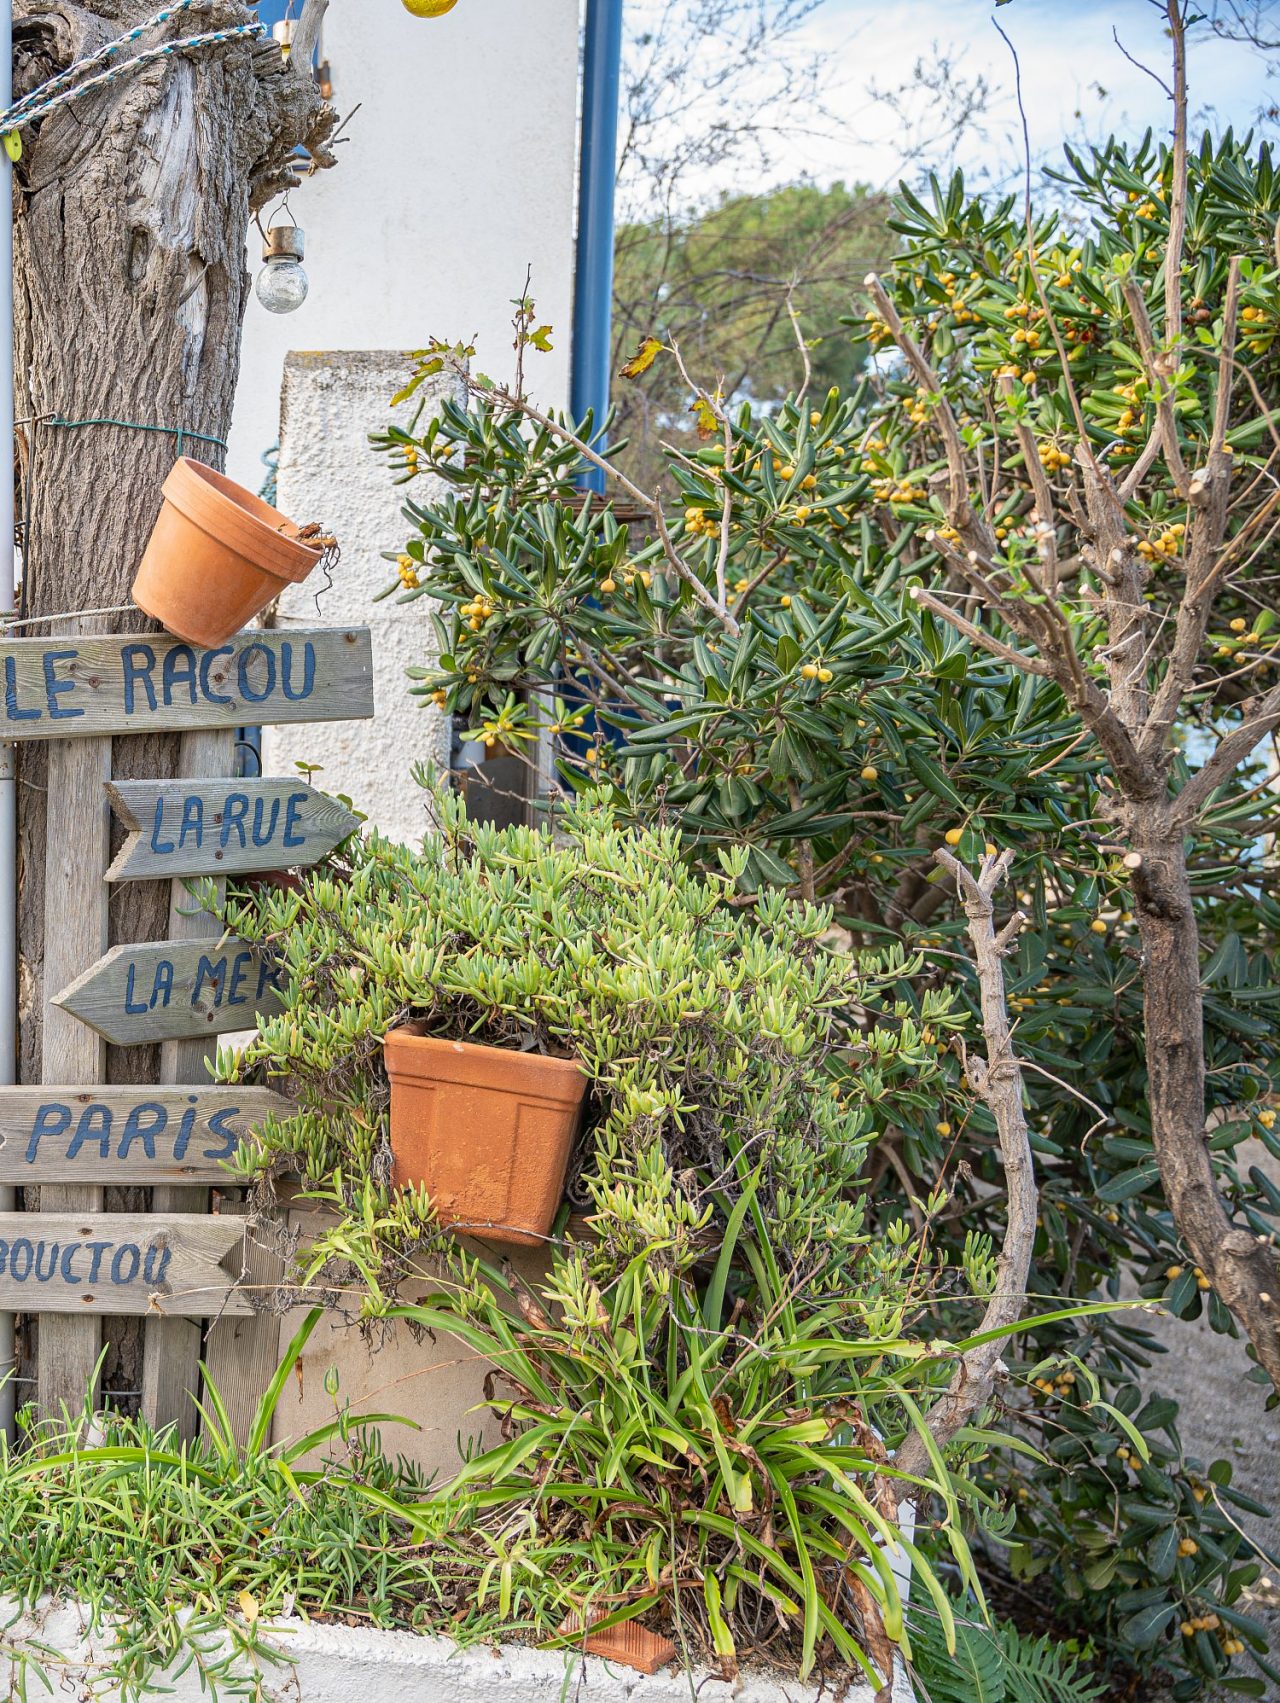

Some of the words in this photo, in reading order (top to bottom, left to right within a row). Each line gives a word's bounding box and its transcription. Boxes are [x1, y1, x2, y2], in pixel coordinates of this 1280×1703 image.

[5, 650, 85, 720] LE
[121, 641, 317, 715] RACOU
[150, 796, 203, 854] LA
[221, 792, 309, 849] RUE
[125, 960, 174, 1014] LA
